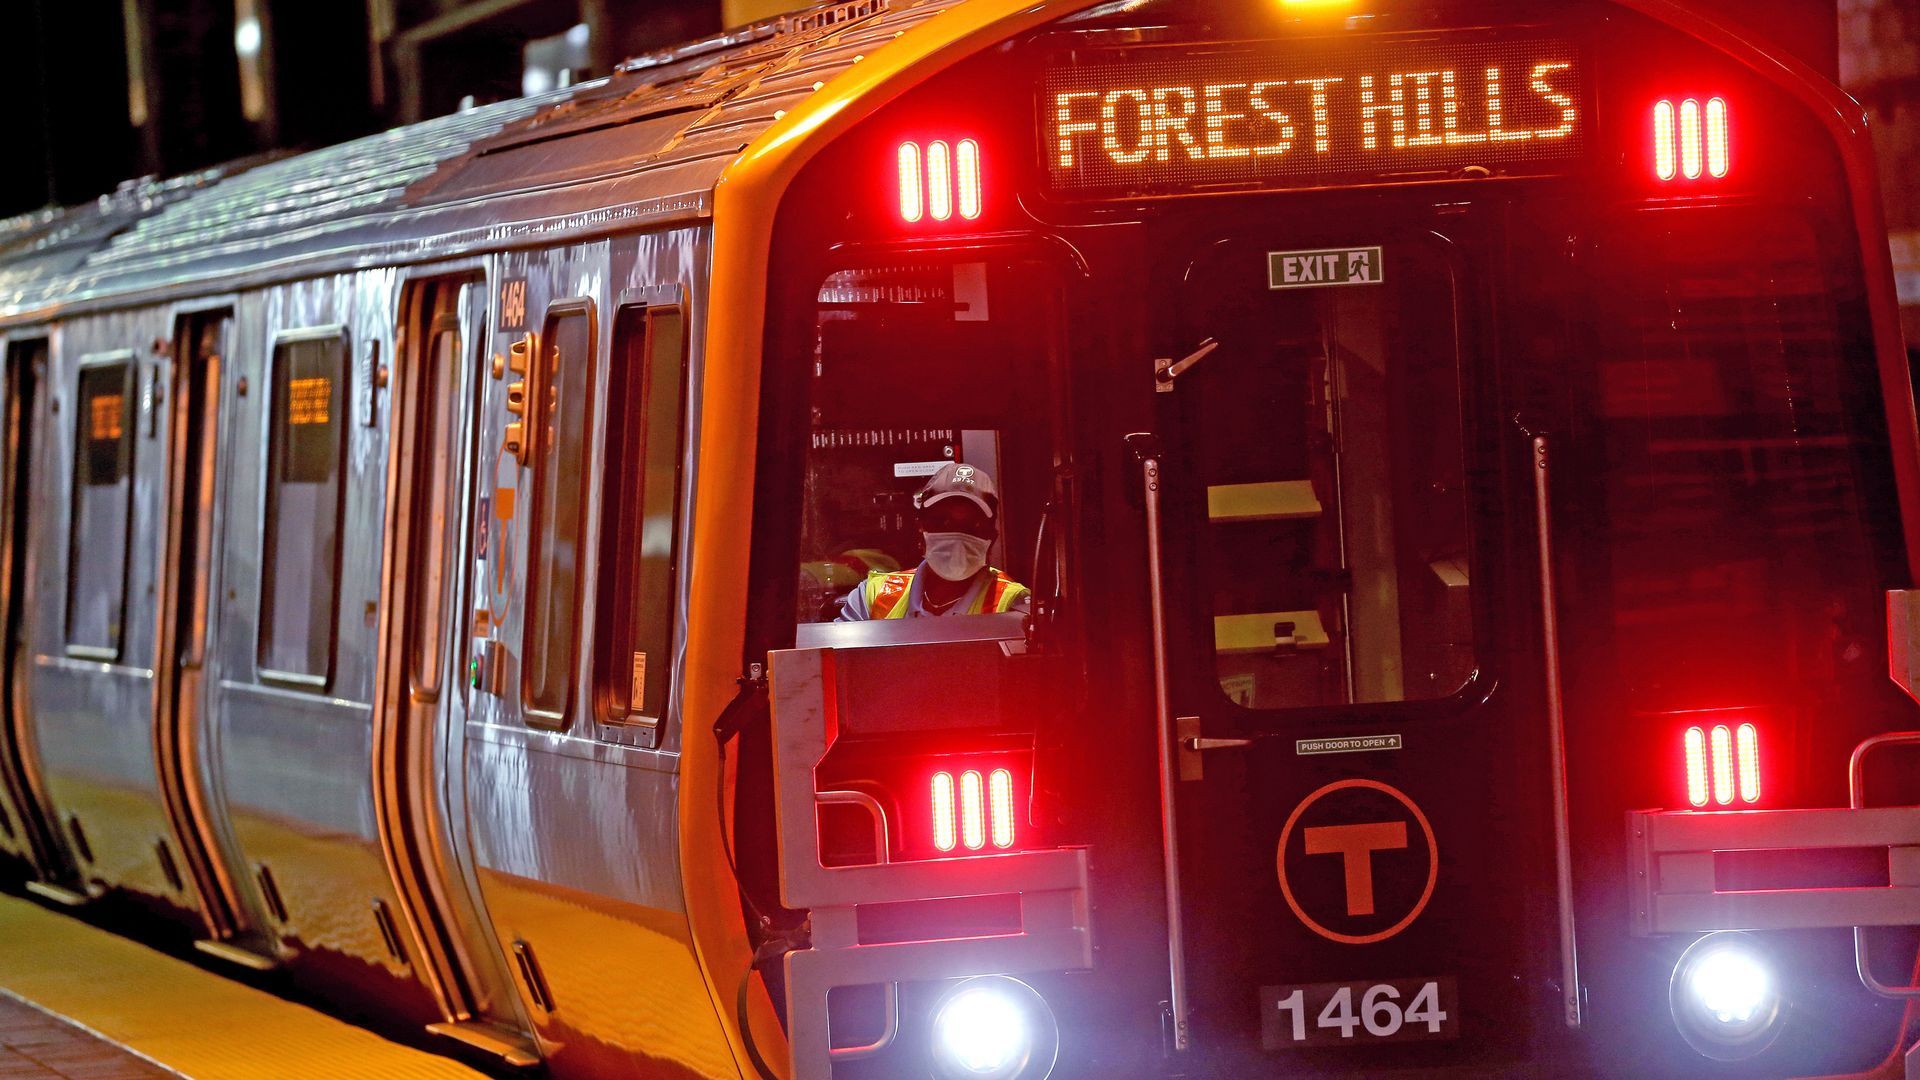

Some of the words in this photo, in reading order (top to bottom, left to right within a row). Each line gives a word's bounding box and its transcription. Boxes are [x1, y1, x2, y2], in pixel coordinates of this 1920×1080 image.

[1057, 77, 1344, 167] FOREST
[1360, 63, 1575, 149] HILLS
[1283, 254, 1339, 283] EXIT
[501, 280, 526, 328] 1464
[1301, 742, 1324, 751] PUSH
[1325, 741, 1350, 749] DOOR
[1350, 740, 1361, 748] TO
[1362, 739, 1386, 747] OPEN
[1304, 821, 1408, 916] T
[1277, 981, 1447, 1041] 1464
